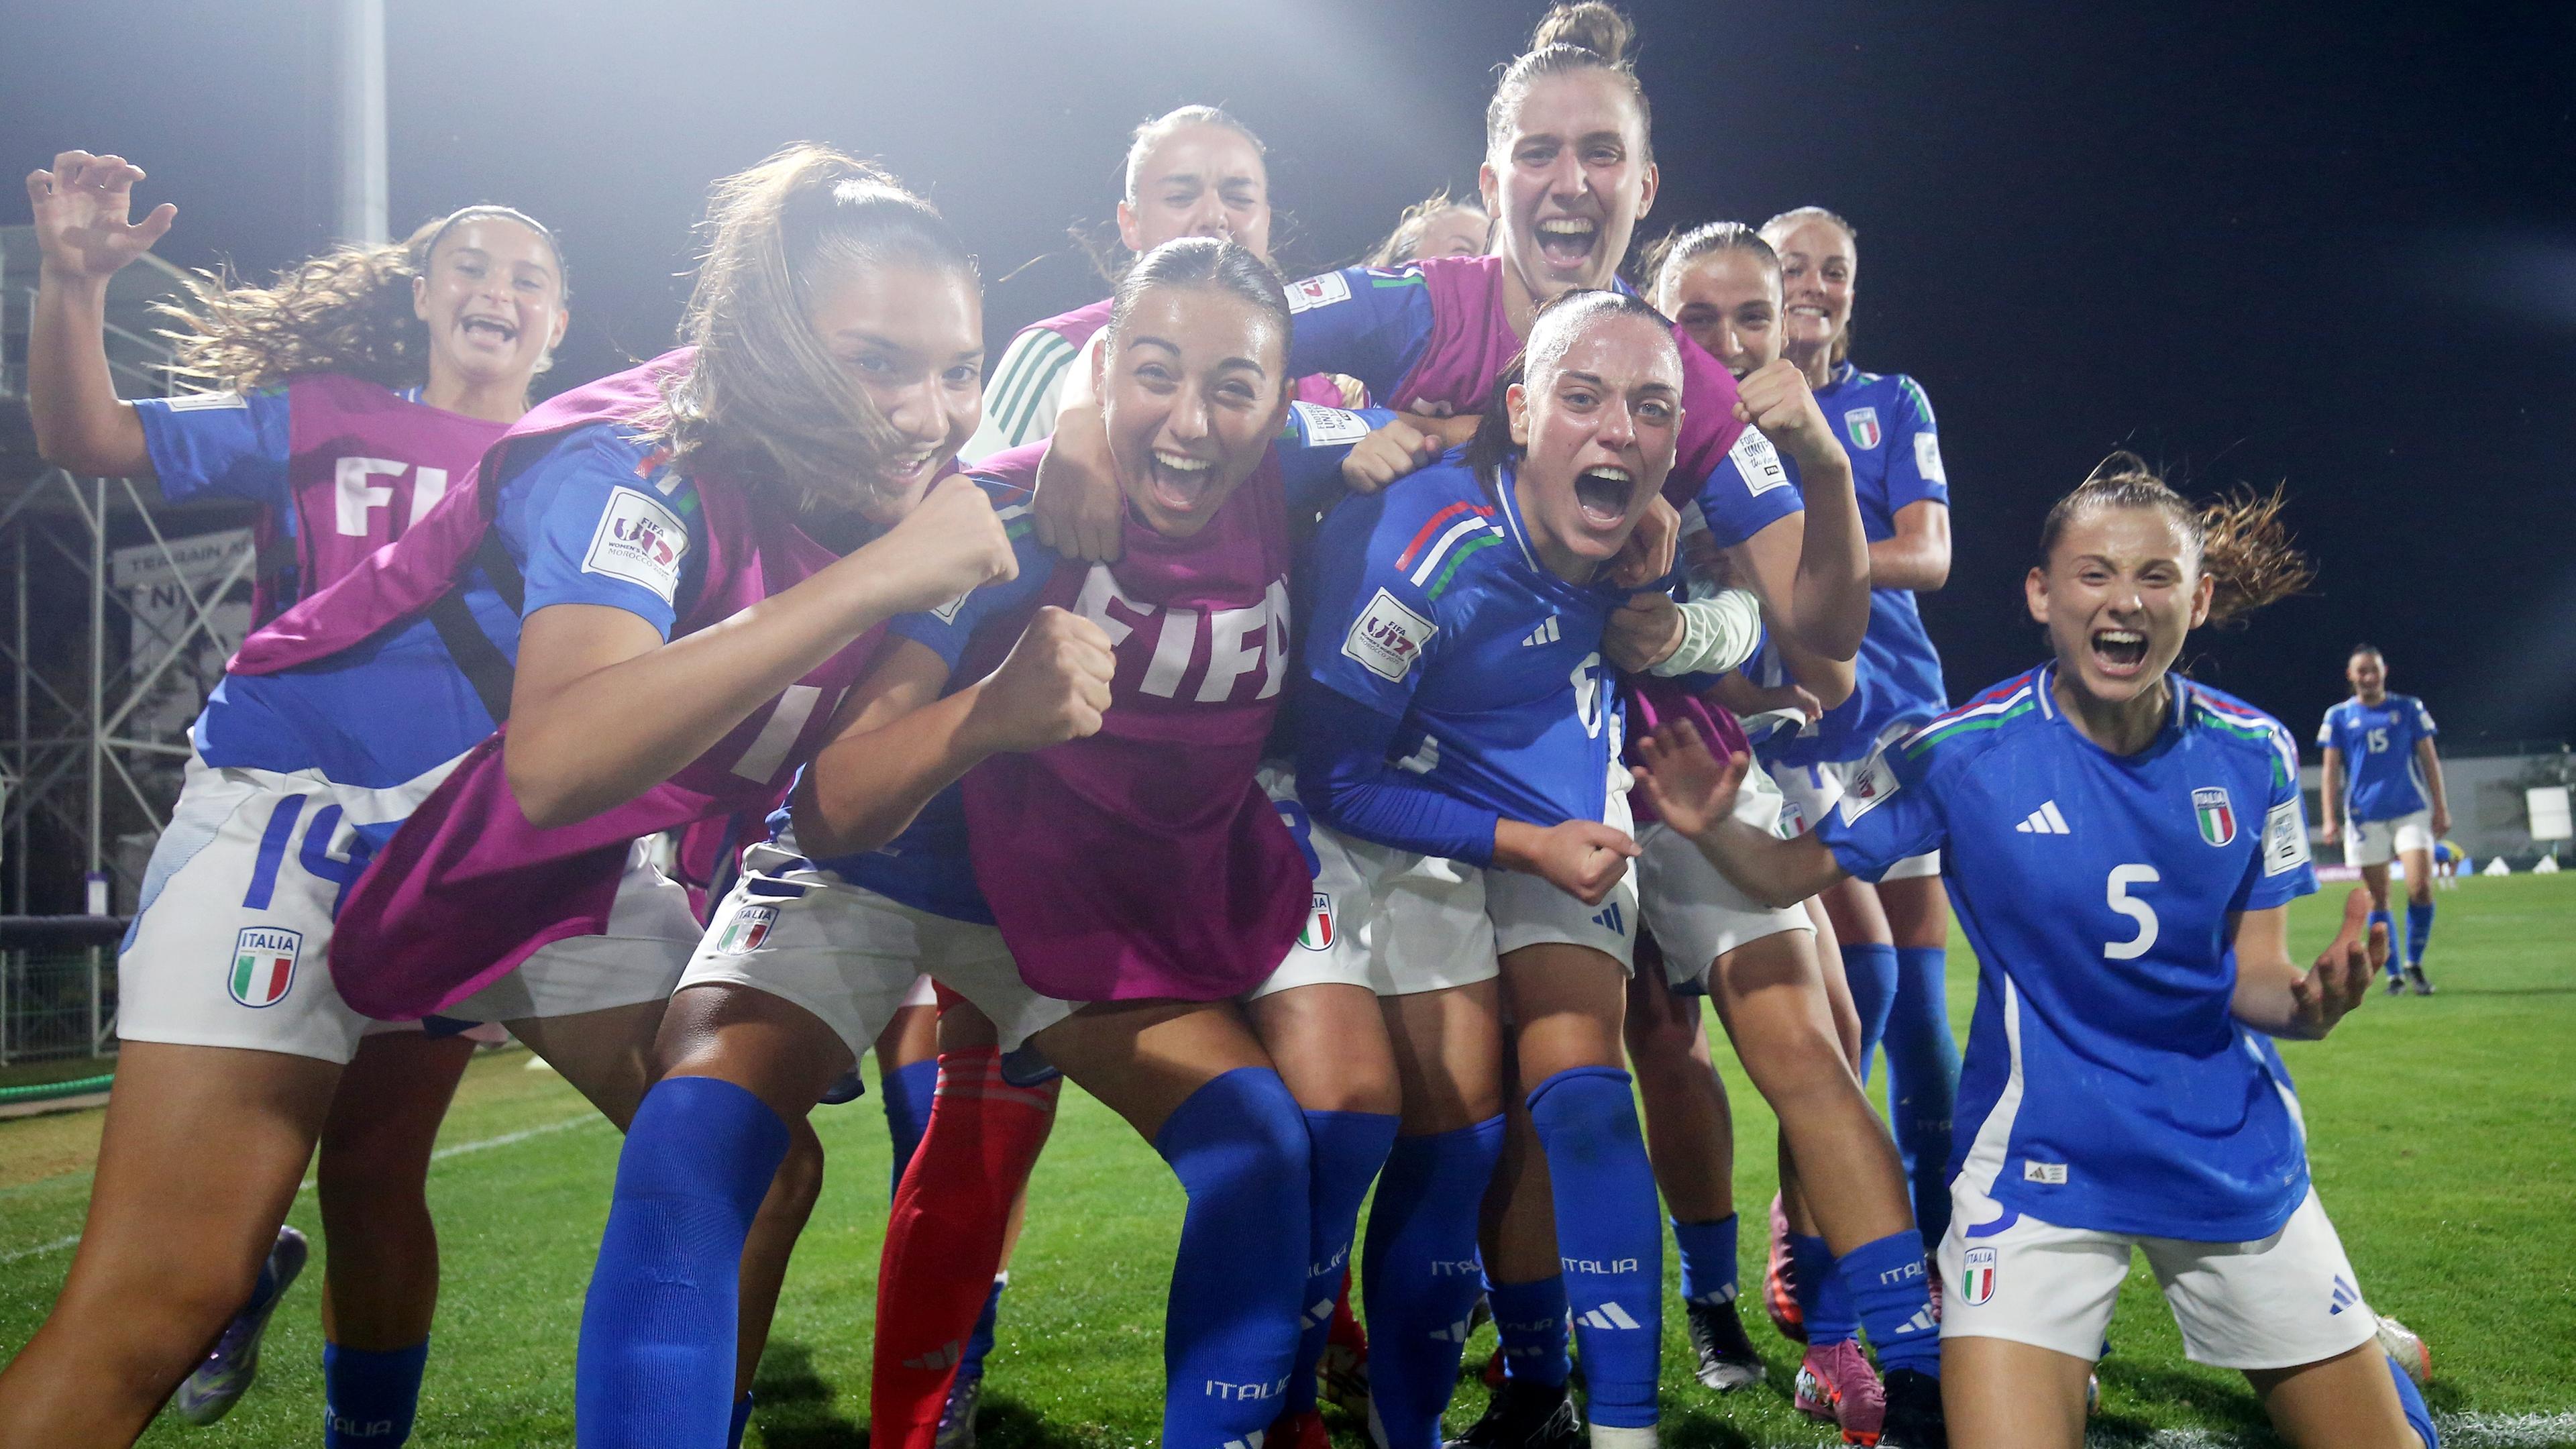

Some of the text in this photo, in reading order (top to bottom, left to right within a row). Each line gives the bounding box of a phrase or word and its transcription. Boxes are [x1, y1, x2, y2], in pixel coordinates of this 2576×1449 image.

[335, 456, 448, 537] FI
[641, 517, 665, 537] FIFA
[608, 547, 653, 568] MOROCCO
[1367, 616, 1415, 655] U17
[1388, 621, 1407, 636] FIFA
[2367, 728, 2389, 755] 15
[2104, 863, 2160, 959] 5
[242, 933, 294, 951] ITALIA
[1561, 1257, 1638, 1274] ITALIA
[1966, 1252, 1993, 1265] ITALIA
[1880, 1260, 1924, 1285] ITAL
